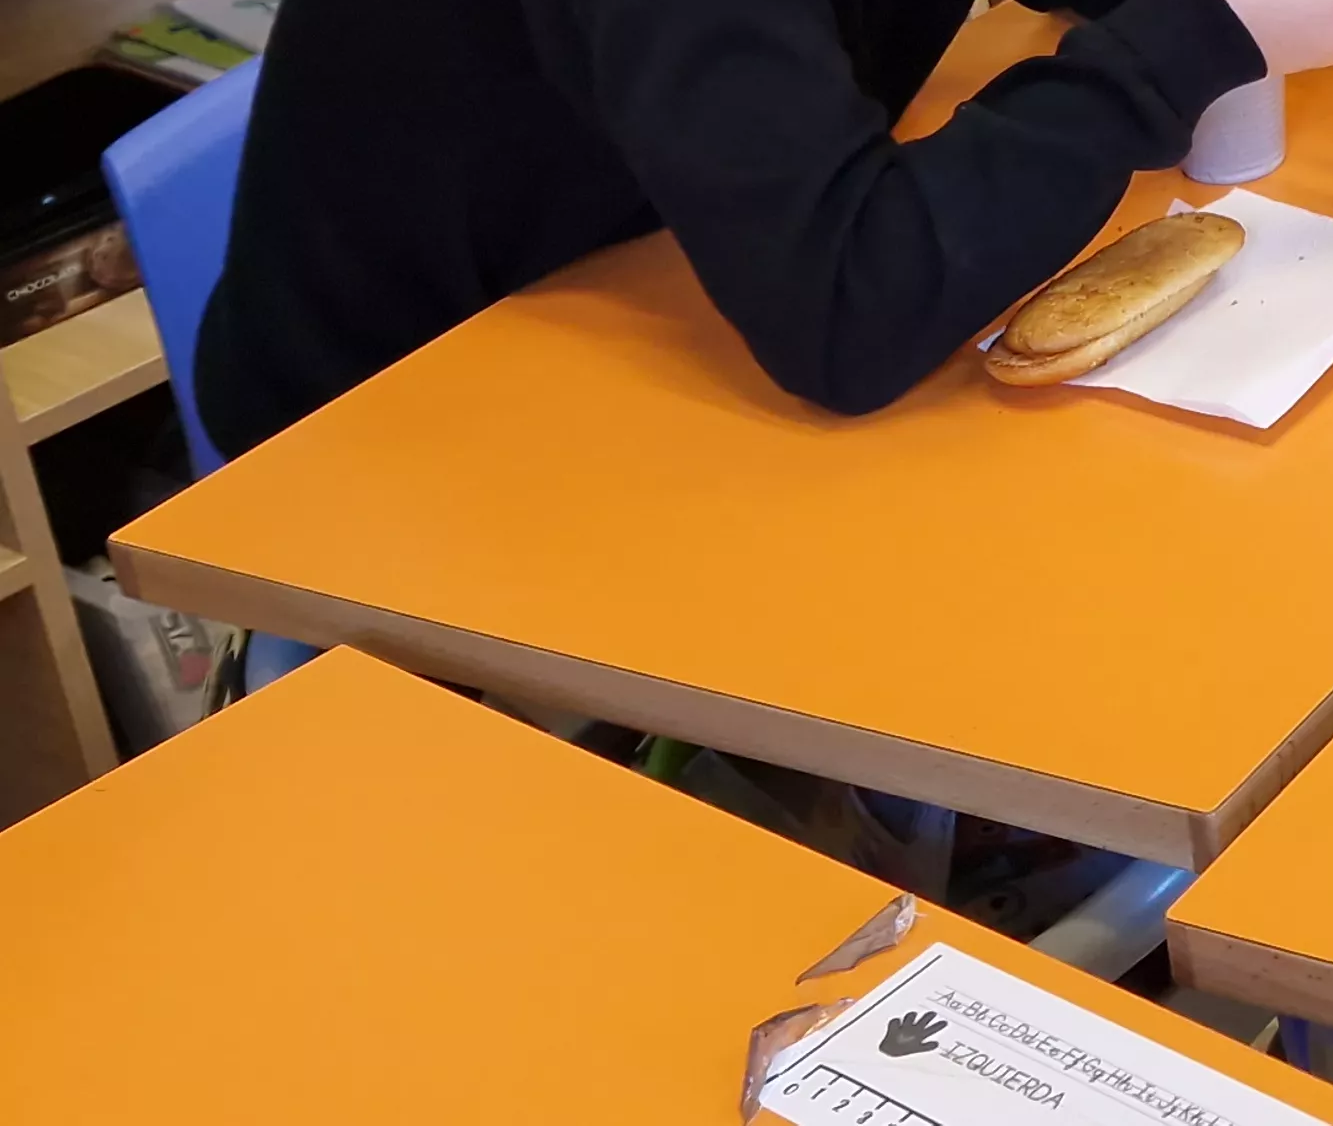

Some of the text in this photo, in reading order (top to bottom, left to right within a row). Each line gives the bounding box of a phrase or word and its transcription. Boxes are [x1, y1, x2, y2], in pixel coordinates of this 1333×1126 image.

[940, 1040, 1066, 1110] IZQUIERDA
[782, 1082, 874, 1125] 0 1 2 3
